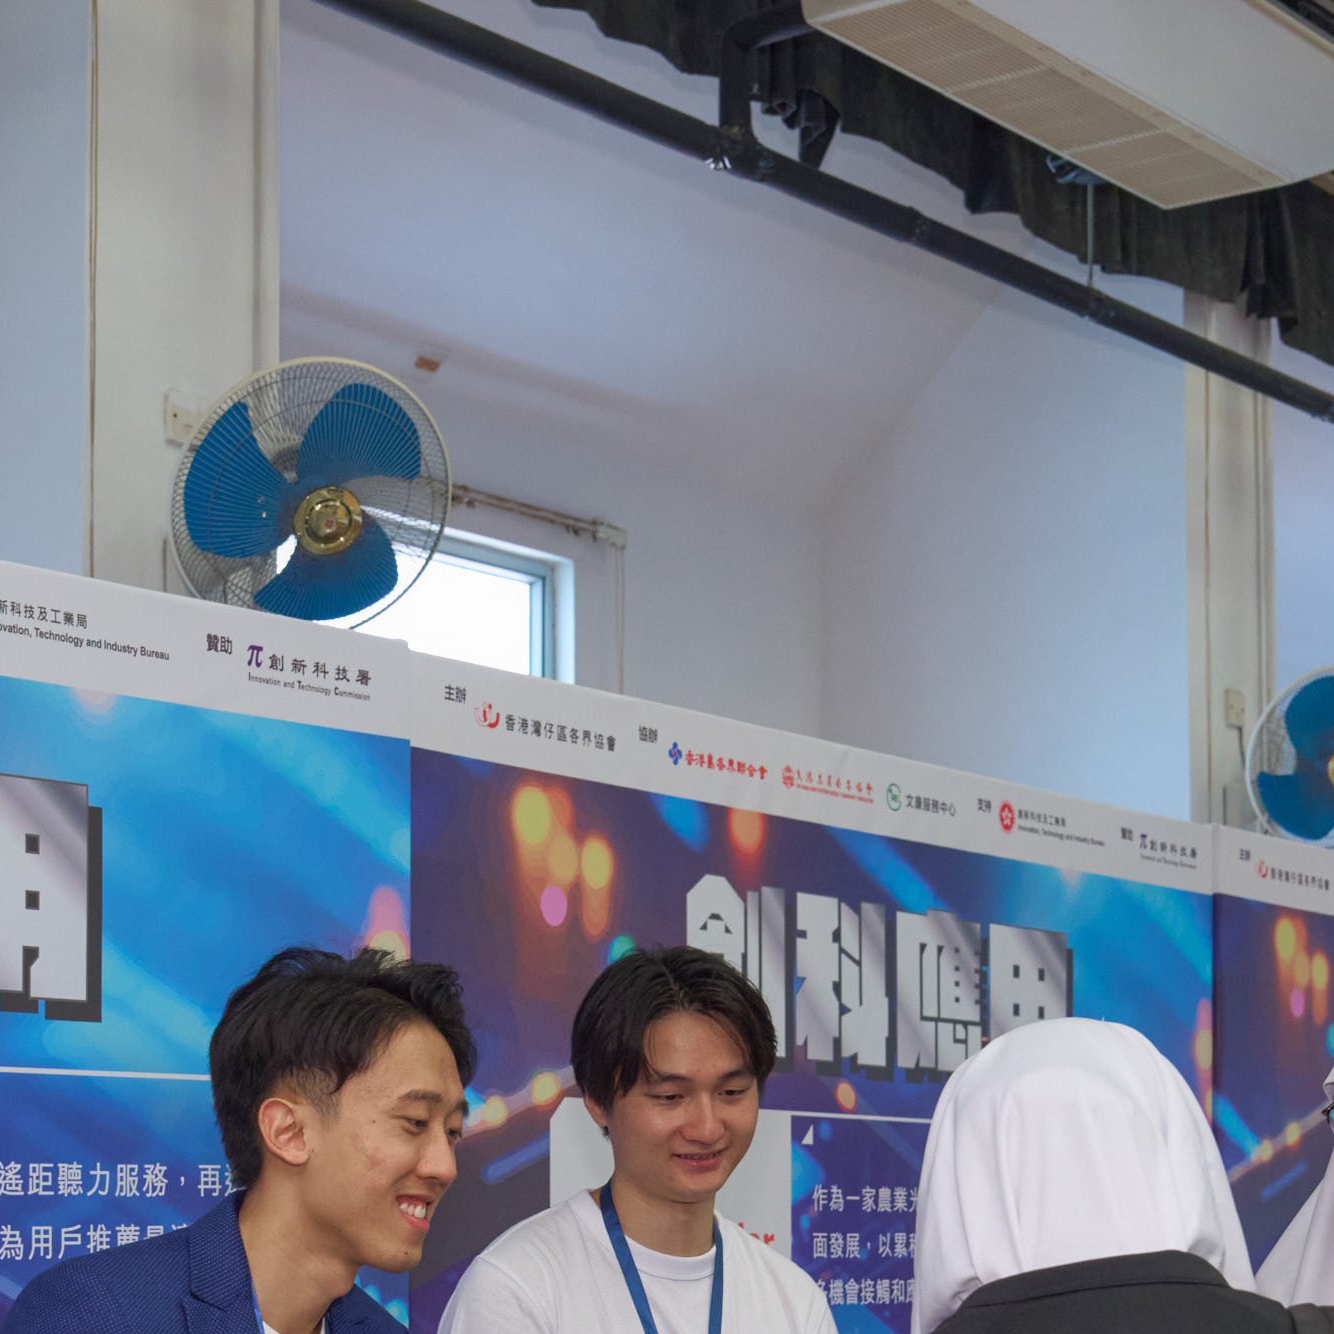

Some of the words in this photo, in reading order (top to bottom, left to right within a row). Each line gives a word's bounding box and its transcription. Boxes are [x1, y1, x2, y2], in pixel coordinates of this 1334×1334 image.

[33, 627, 85, 648] Technology
[86, 637, 102, 649] and
[103, 639, 139, 657] Industry
[140, 646, 170, 661] Bureau
[268, 653, 372, 686] 創新科技署
[248, 672, 281, 688] Innovation
[283, 680, 295, 689] and
[297, 679, 331, 696] Technology
[334, 686, 372, 701] Commission
[443, 684, 467, 705] 主辦
[504, 713, 617, 753] 香港灣仔區各界協會
[812, 1232, 916, 1259] 面發展，以累
